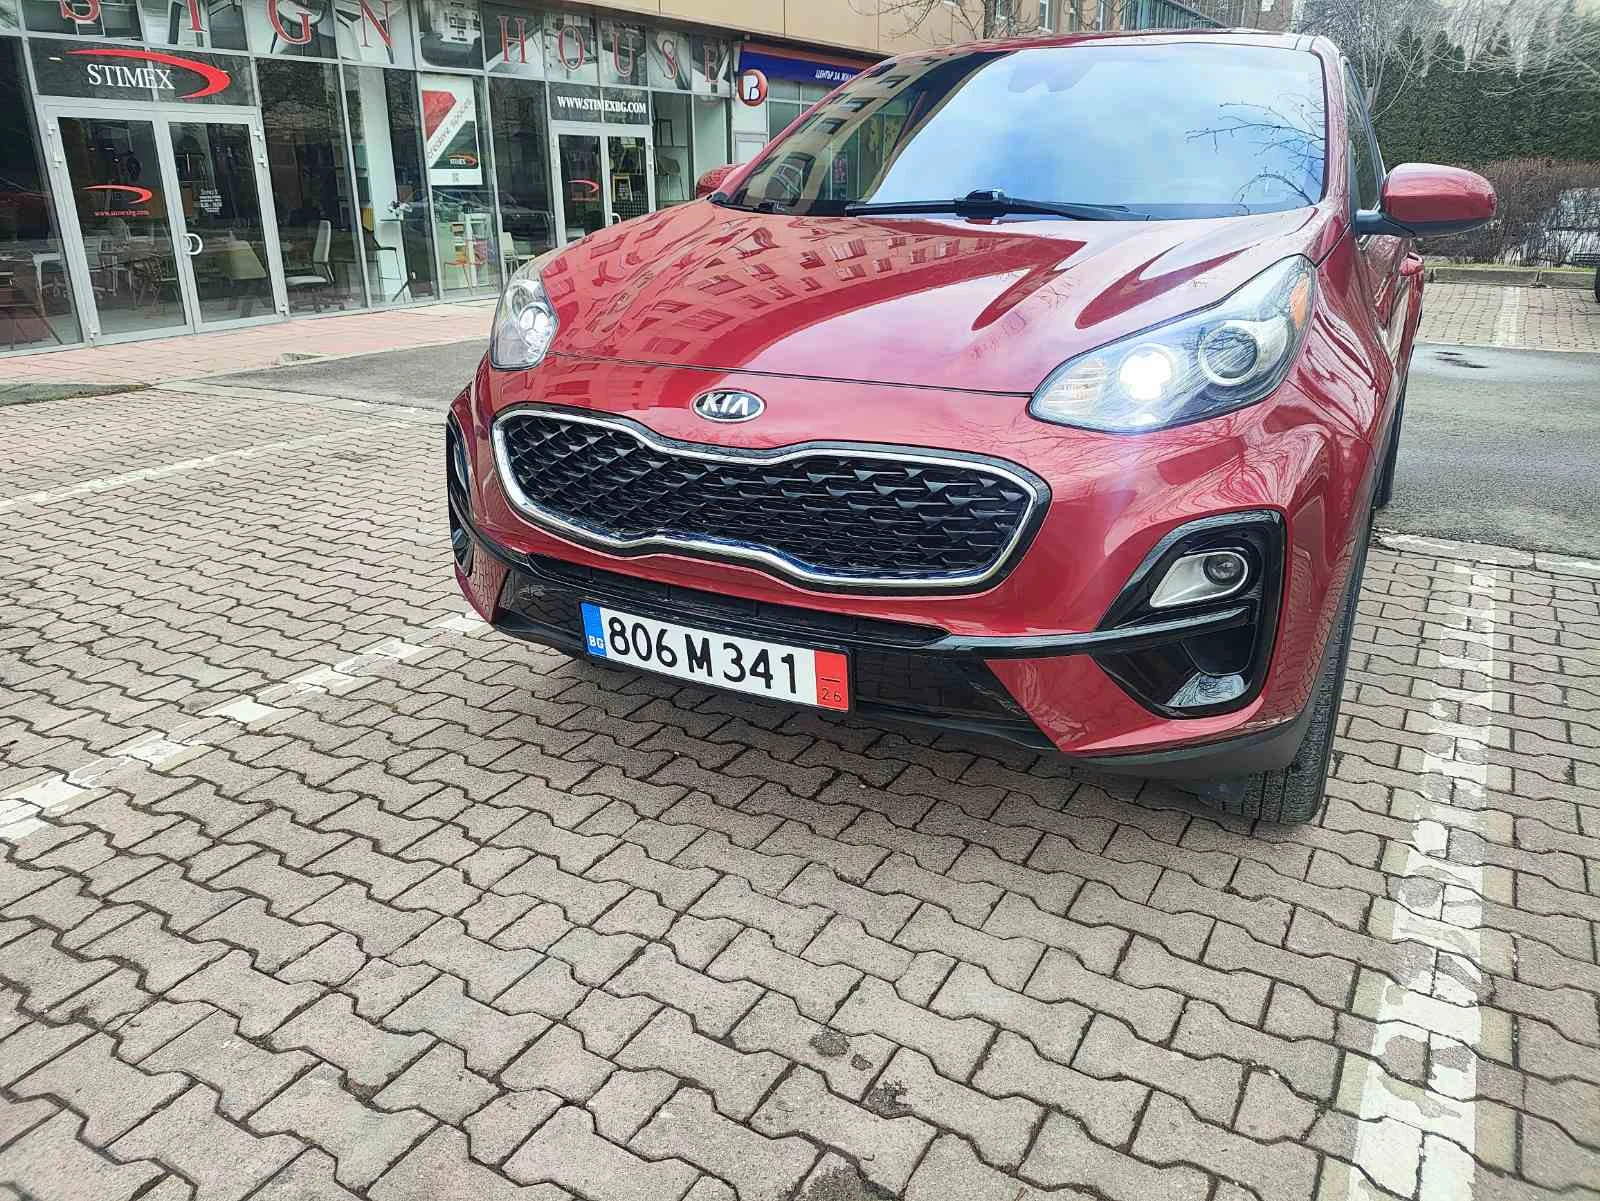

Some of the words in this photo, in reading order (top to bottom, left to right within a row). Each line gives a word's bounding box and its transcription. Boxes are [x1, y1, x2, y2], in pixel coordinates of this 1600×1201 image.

[498, 15, 720, 84] HOUSE
[87, 63, 175, 89] STIMEX
[557, 96, 647, 114] WWW.STIMEXBG.COM
[702, 392, 750, 416] KIA
[588, 634, 605, 650] BG
[608, 616, 678, 668] 806
[685, 633, 713, 677] M
[722, 642, 797, 694] 341
[821, 687, 842, 703] 26
